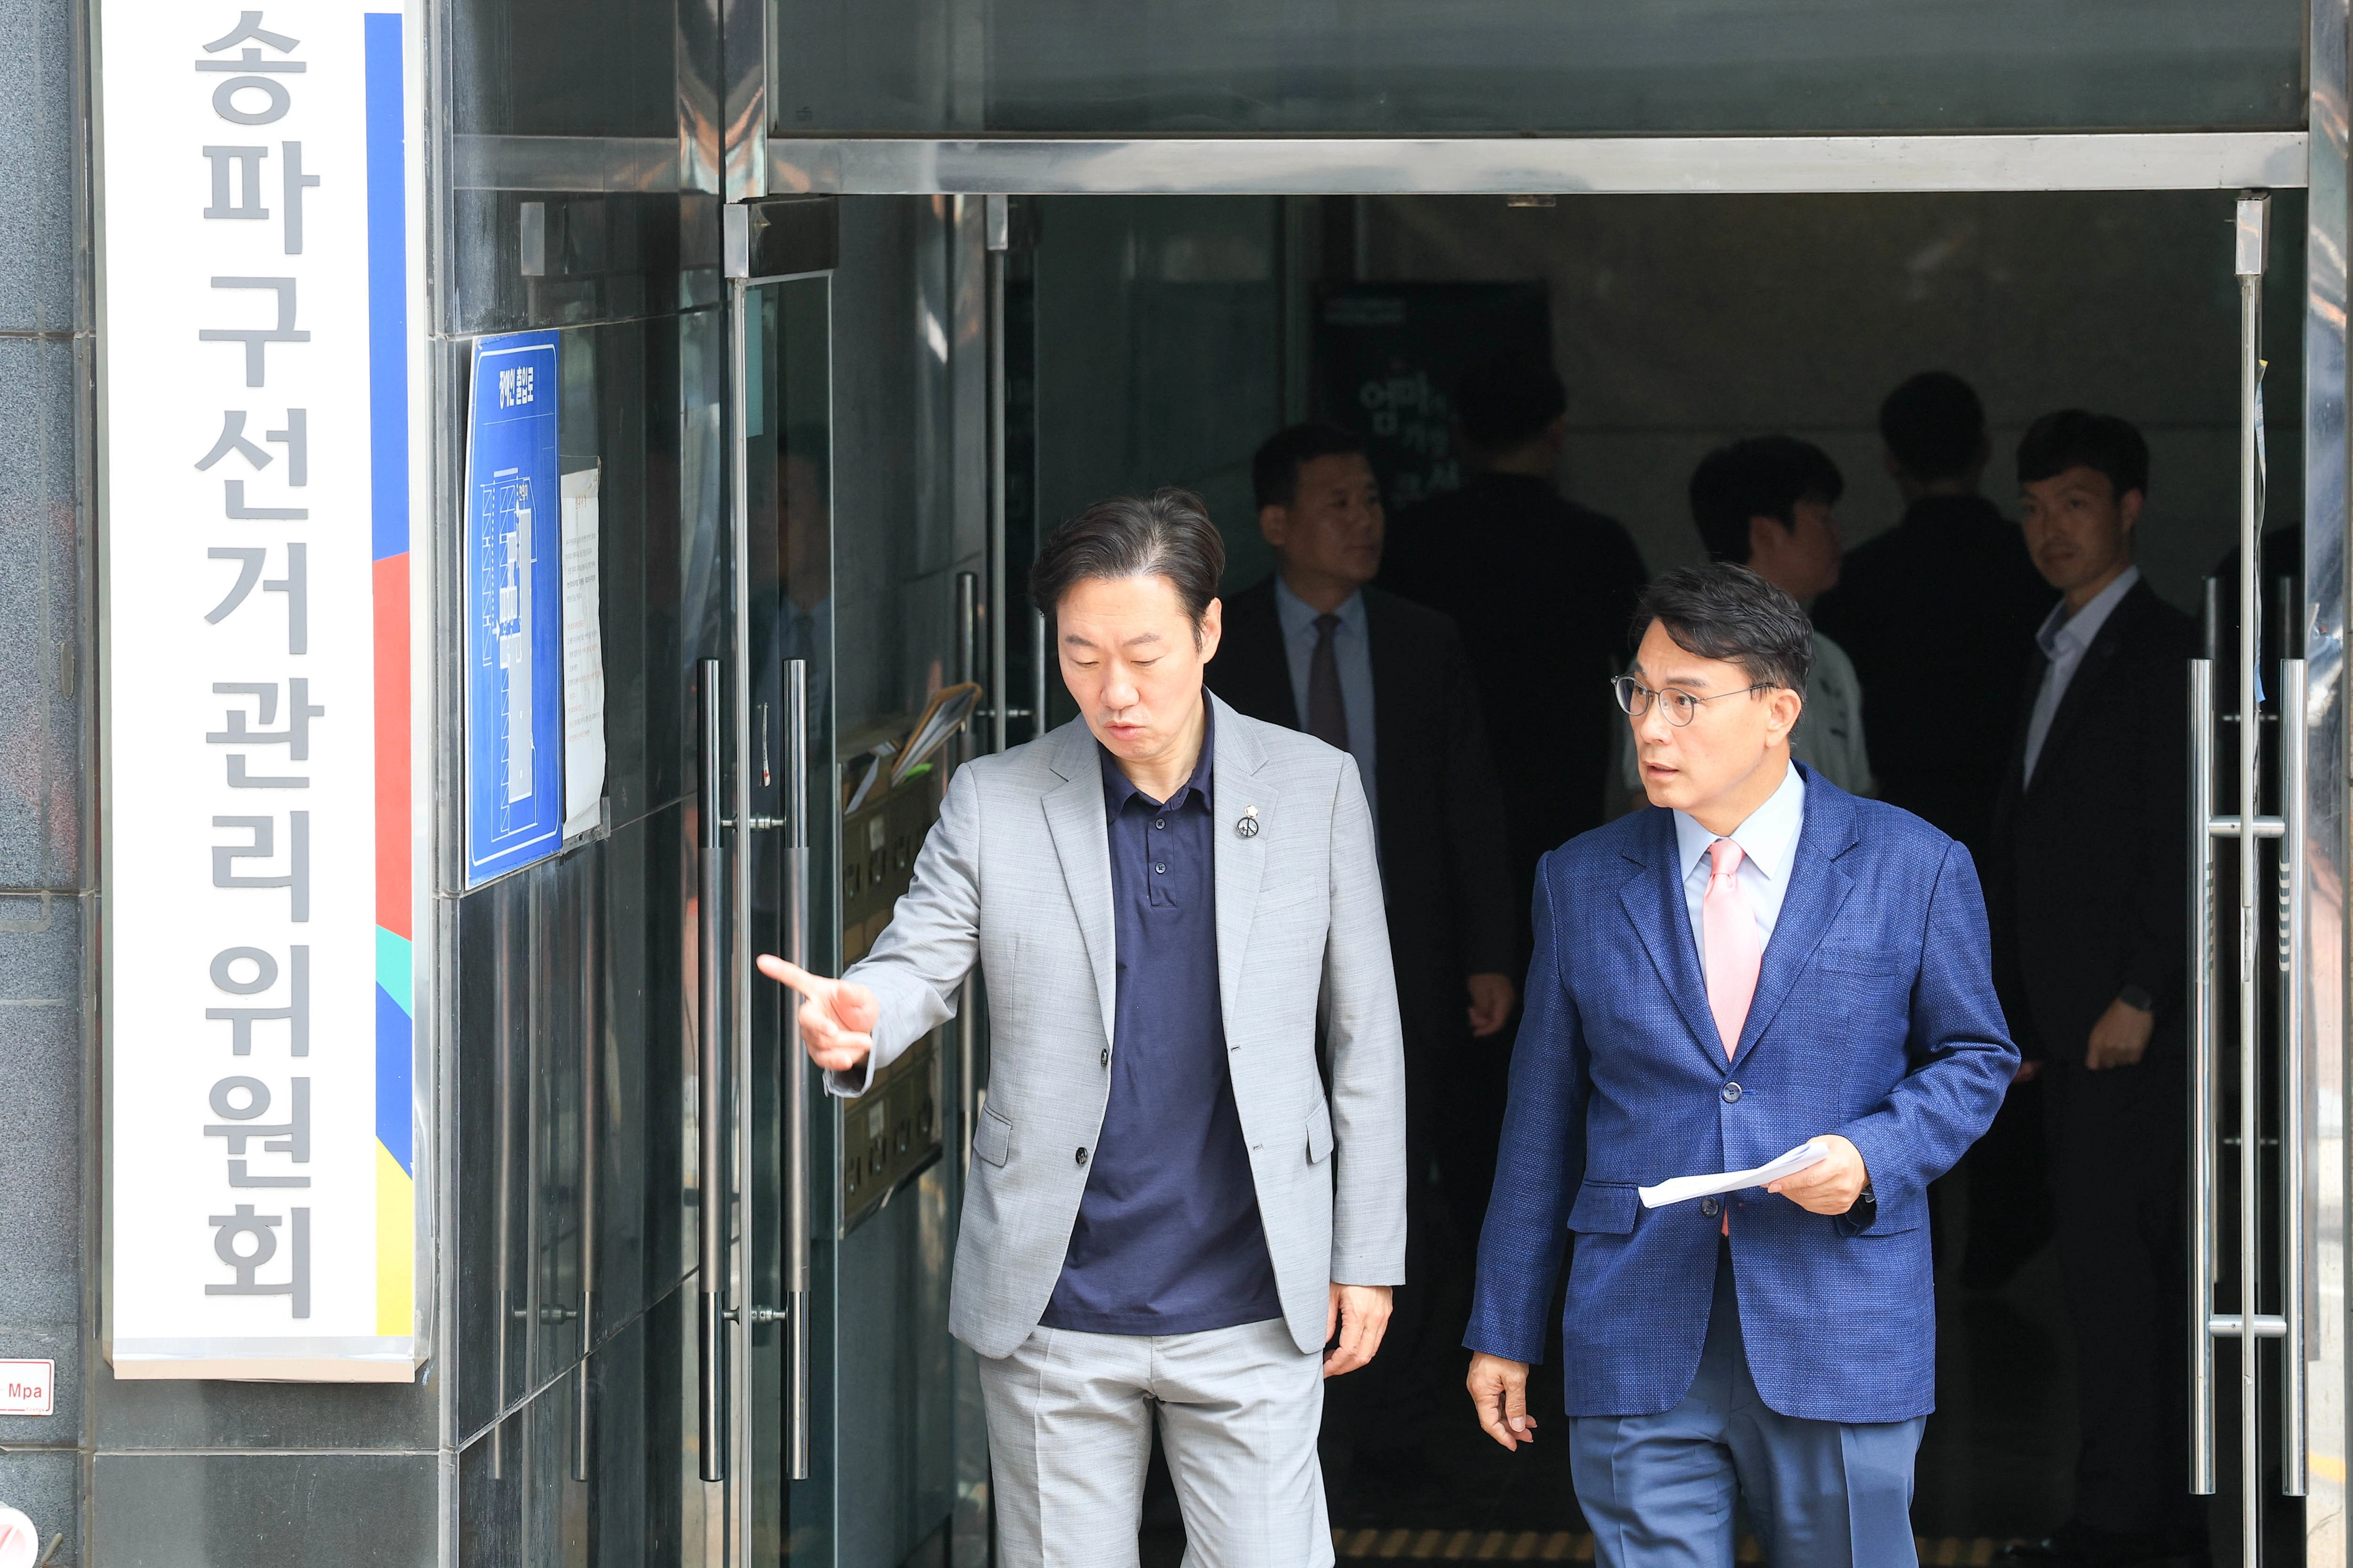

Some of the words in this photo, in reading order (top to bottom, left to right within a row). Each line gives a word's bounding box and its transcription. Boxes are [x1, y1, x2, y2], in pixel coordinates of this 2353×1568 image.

[499, 368, 515, 410] 장애인
[516, 365, 534, 405] 출입로
[195, 11, 325, 1319] 송파구선거관리위원회
[9, 1383, 42, 1400] Mpa
